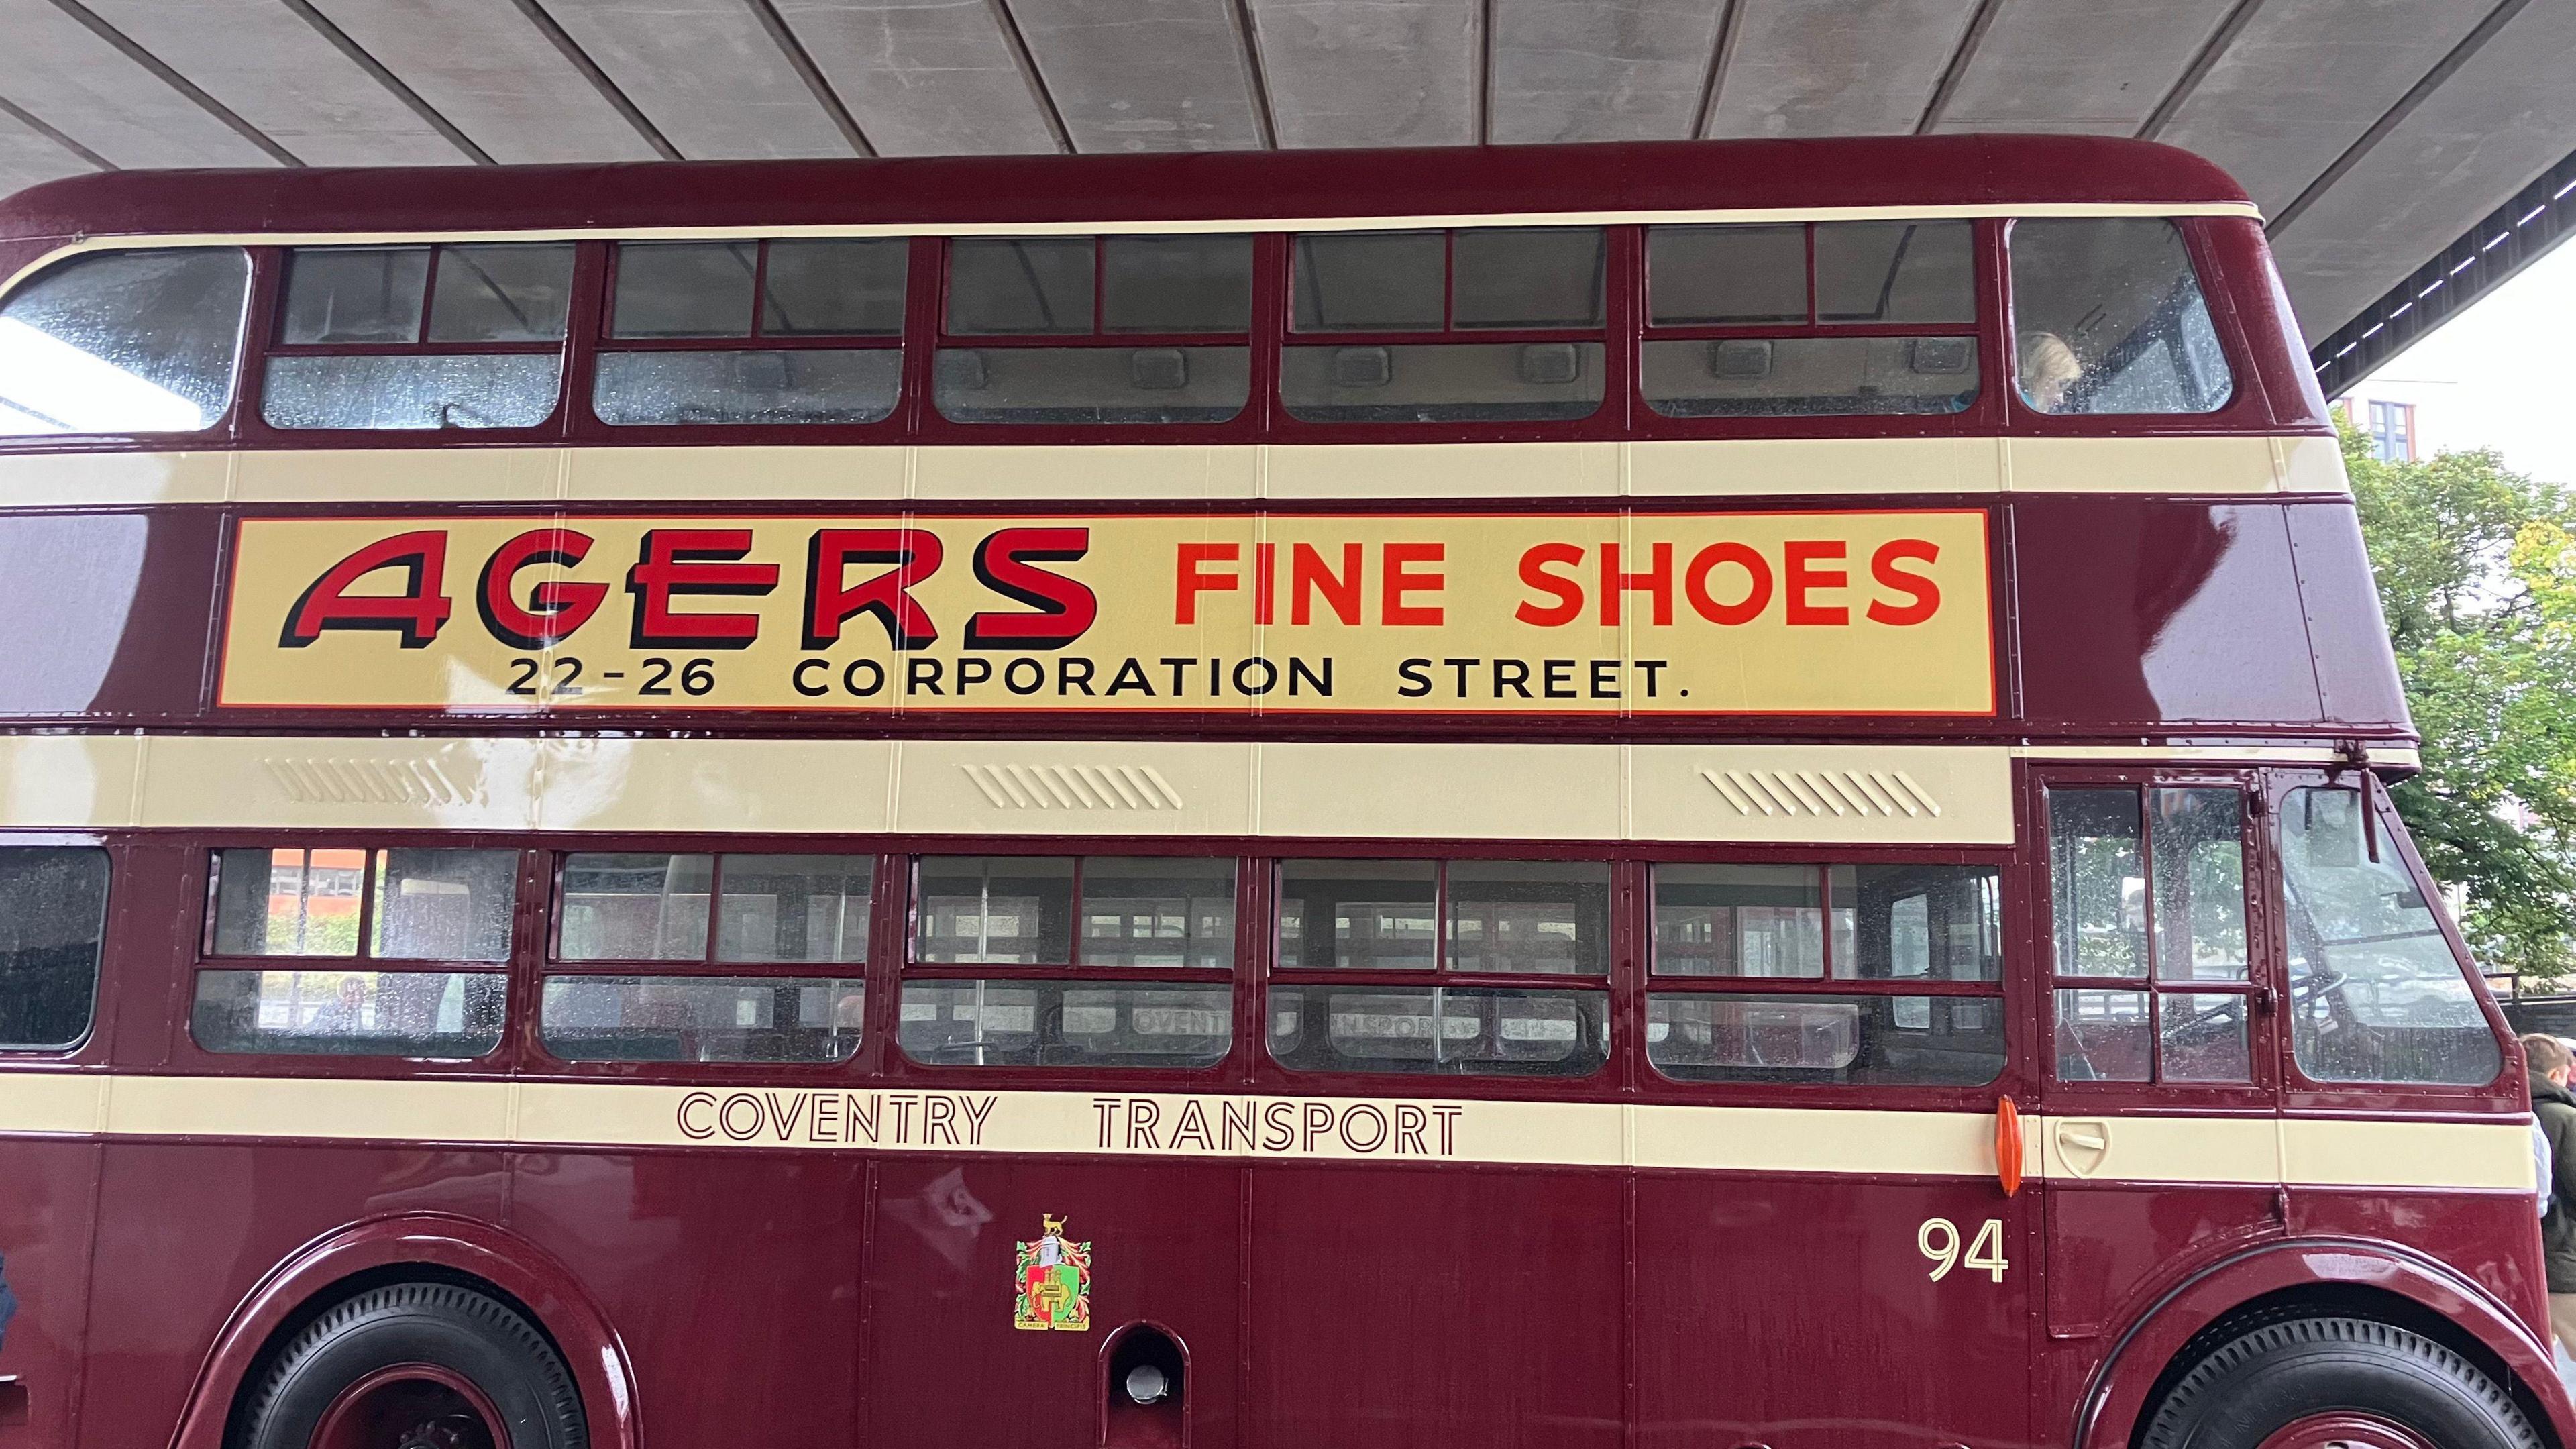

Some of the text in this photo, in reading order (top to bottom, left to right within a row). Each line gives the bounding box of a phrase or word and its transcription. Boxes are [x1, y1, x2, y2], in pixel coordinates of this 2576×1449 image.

[278, 527, 1941, 651] AGERS FINE SHOES
[792, 657, 1333, 697] CORPORATION
[1397, 658, 1689, 698] STREET.
[677, 1091, 1463, 1155] COVENTRY TRANSPORT
[1918, 1218, 2008, 1283] 94
